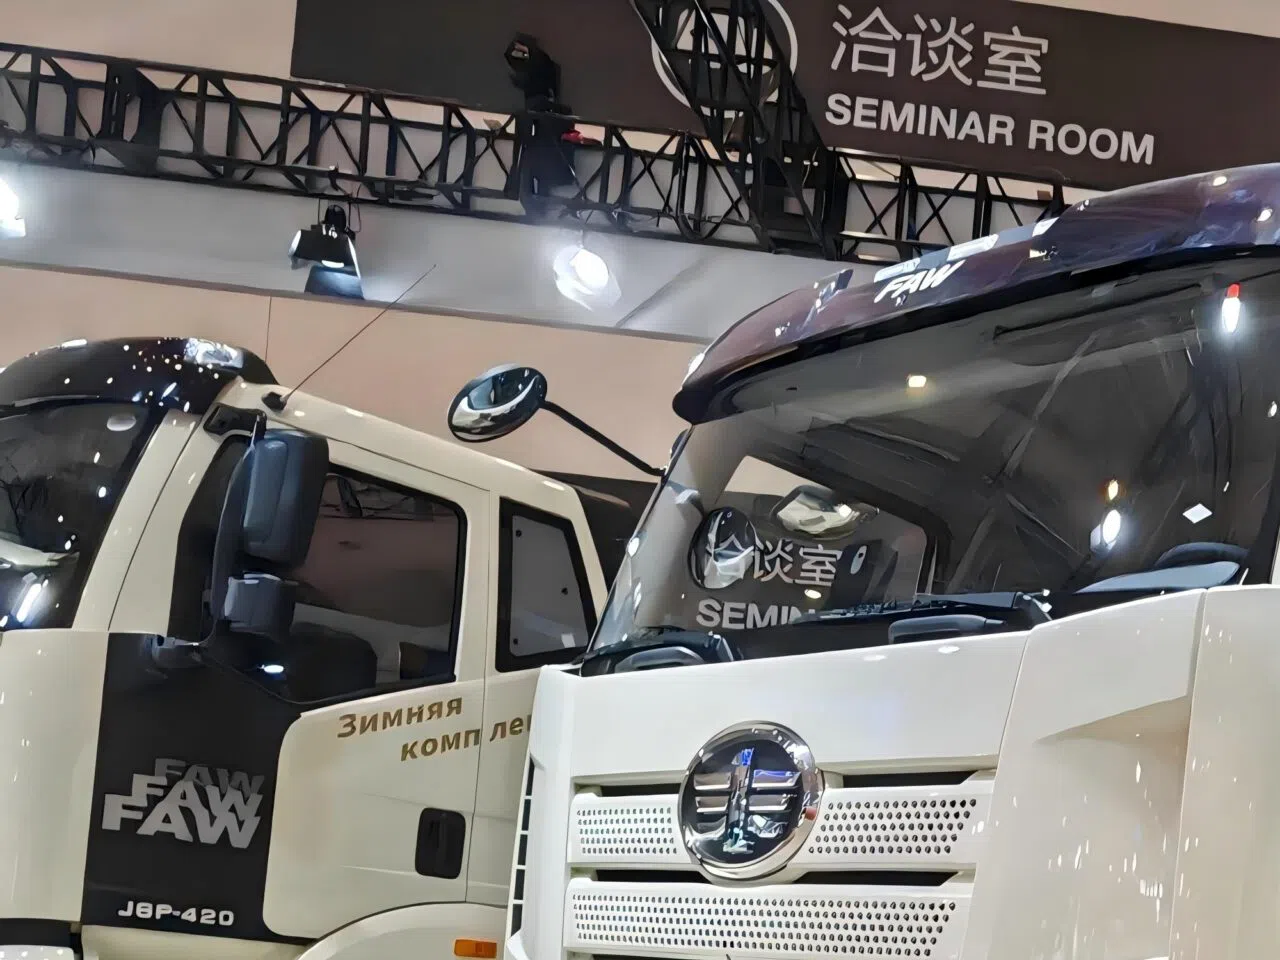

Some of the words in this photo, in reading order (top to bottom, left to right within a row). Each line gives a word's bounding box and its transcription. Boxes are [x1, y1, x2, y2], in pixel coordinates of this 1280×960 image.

[831, 4, 1049, 95] 洽谈室
[825, 93, 1015, 146] SEMINAR
[1028, 119, 1155, 165] ROOM
[873, 259, 966, 304] FAW
[337, 697, 463, 738] Зимняя
[400, 714, 532, 762] компле
[102, 793, 261, 849] FAW
